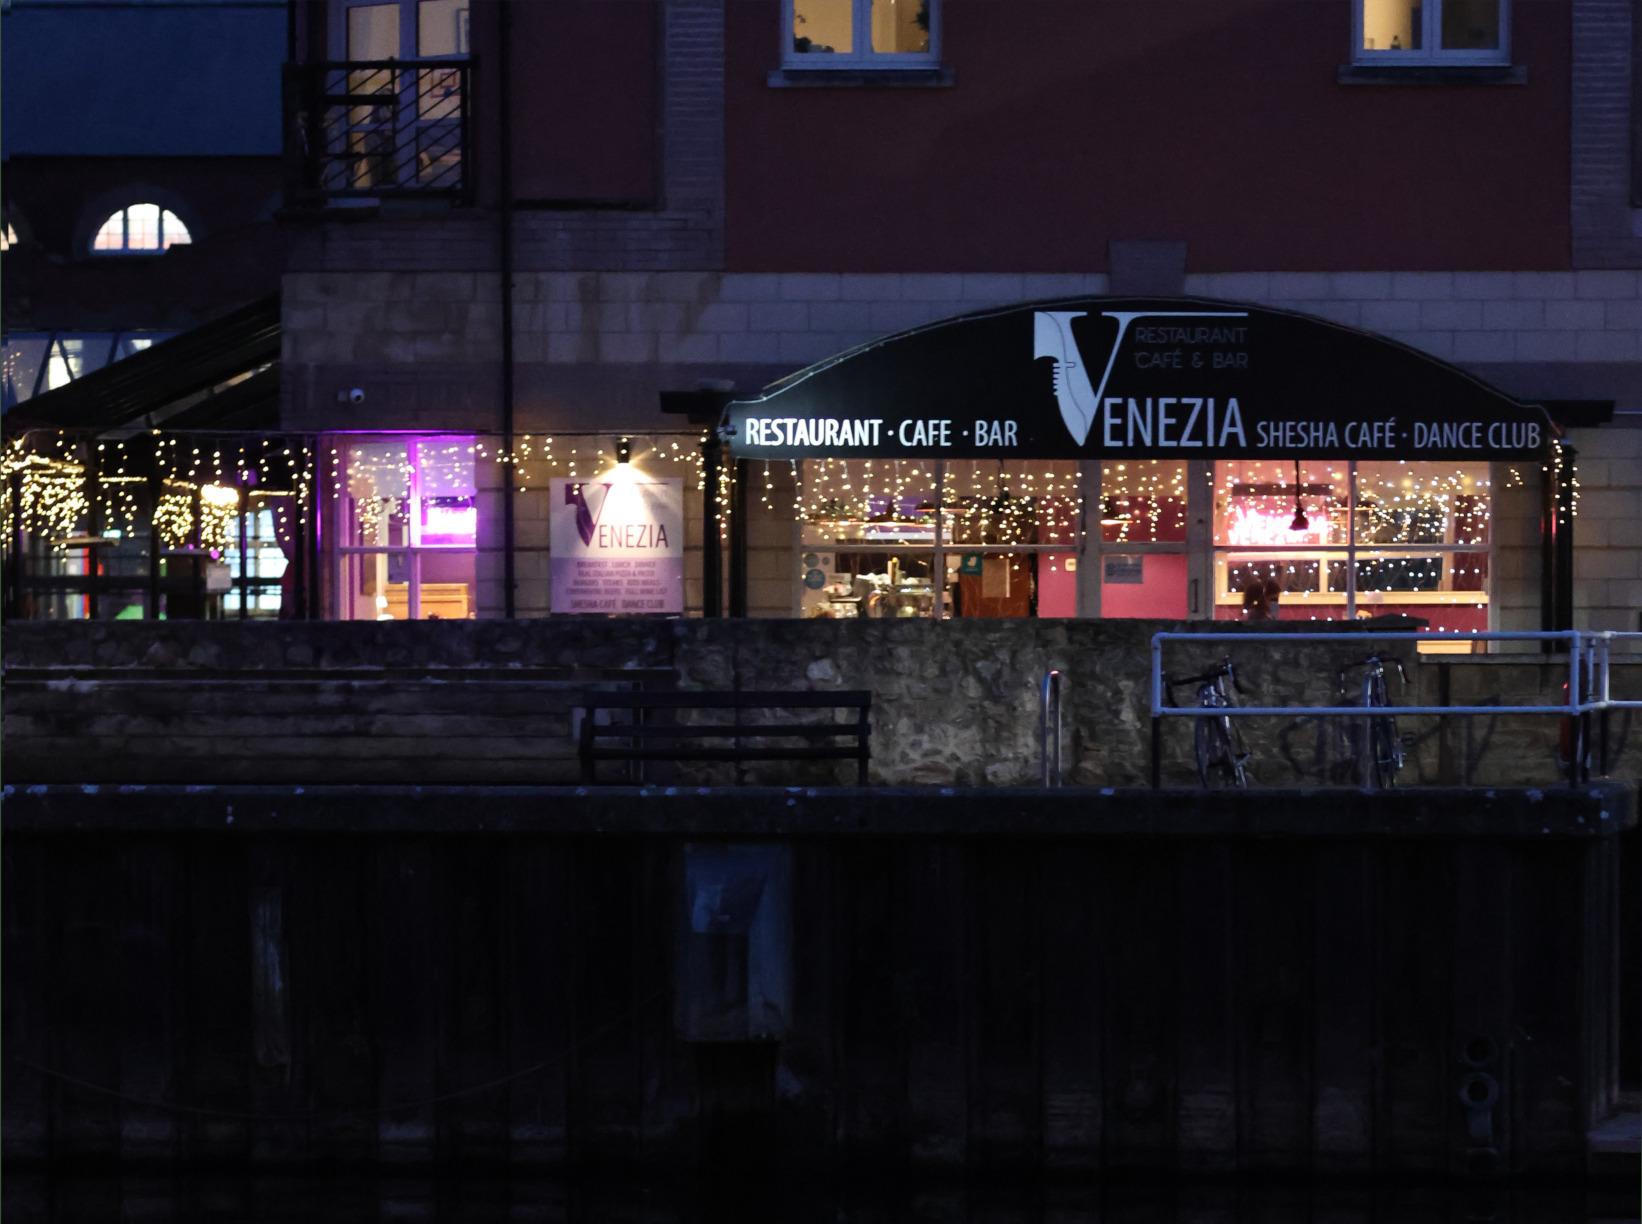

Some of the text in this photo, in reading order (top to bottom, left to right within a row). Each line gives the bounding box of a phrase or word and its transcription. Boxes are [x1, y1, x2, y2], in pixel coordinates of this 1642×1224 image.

[1135, 327, 1248, 344] RESTAURANT
[1191, 352, 1205, 368] &
[1212, 352, 1248, 368] BAR
[1033, 311, 1249, 448] VENEZIA
[745, 418, 1018, 446] RESTAURANT CAFE BAR
[1256, 417, 1540, 448] SHESHA CAFÉ DANCE CLUB
[565, 482, 669, 548] VENEZIA
